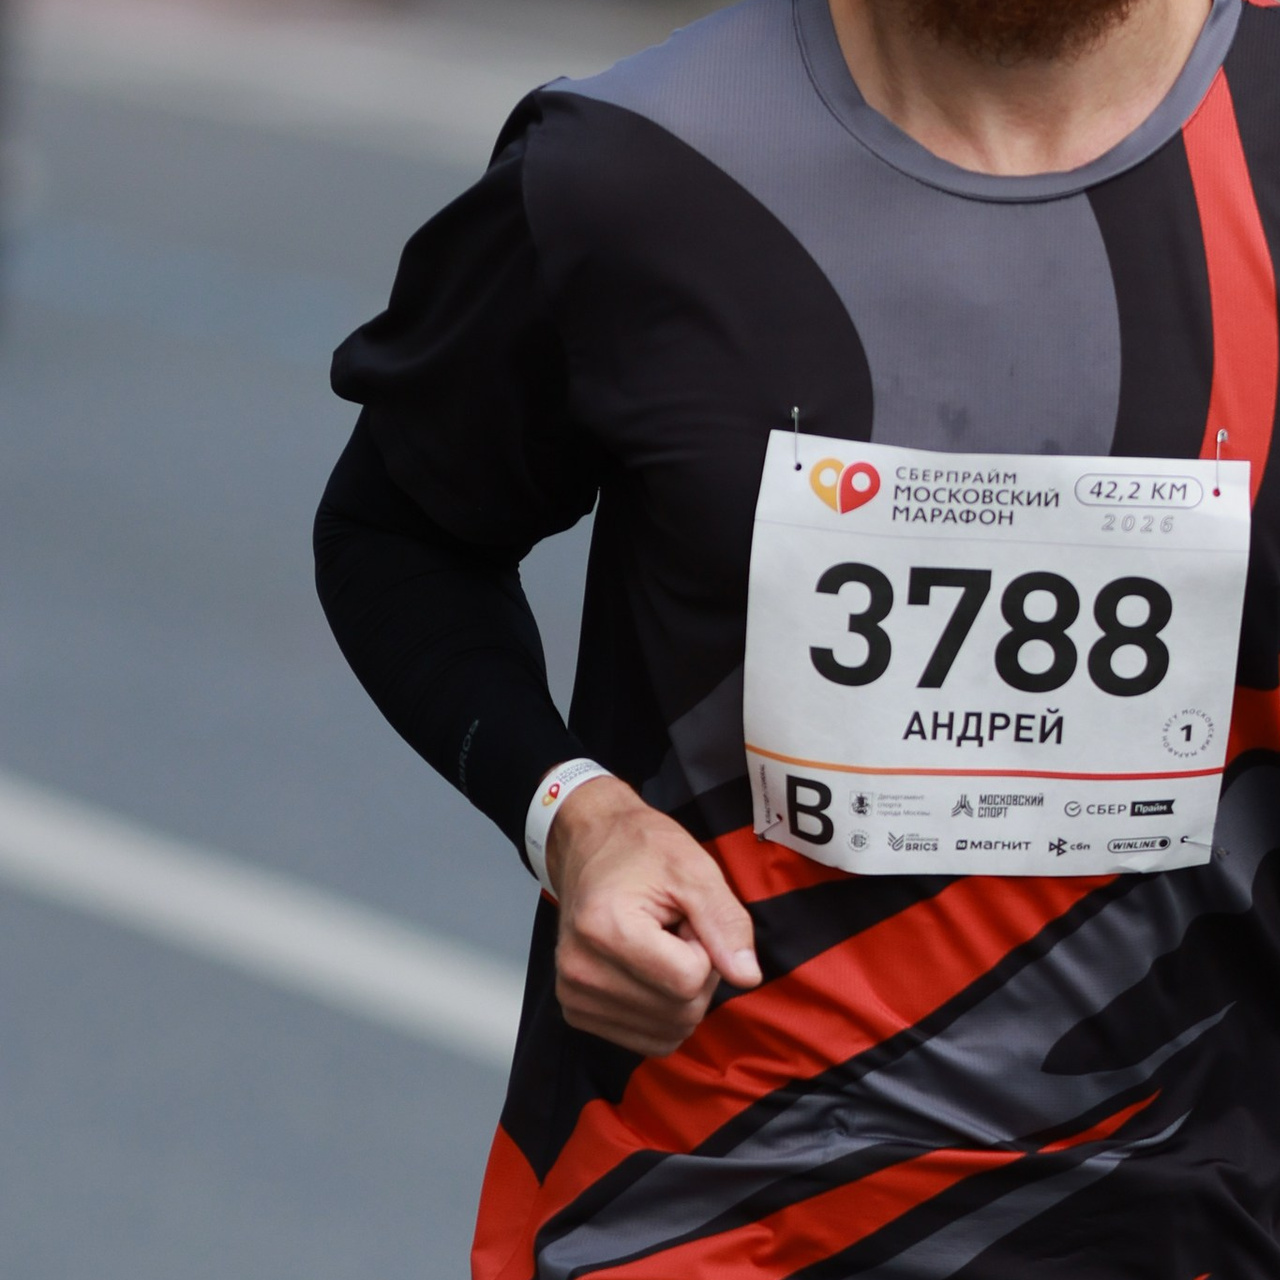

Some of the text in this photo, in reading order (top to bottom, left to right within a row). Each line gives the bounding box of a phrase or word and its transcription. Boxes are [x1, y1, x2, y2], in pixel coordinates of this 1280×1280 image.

[895, 466, 1018, 484] СБЕРПРАЙМ
[893, 484, 1060, 508] МОСКОВСКИЙ
[1089, 480, 1142, 502] 42,2
[891, 506, 1014, 526] МАРАФОН
[1101, 513, 1176, 533] 2026
[808, 561, 1174, 698] 3788
[902, 708, 1065, 747] АНДРЕЙ
[1180, 724, 1192, 742] 1
[978, 792, 1045, 807] МОСКОВСКИЙ
[977, 806, 1009, 819] СПОРТ
[1086, 803, 1127, 816] СБЕР
[905, 842, 939, 852] BRICS
[970, 840, 1032, 851] магнит
[1111, 840, 1157, 851] WINLINE
